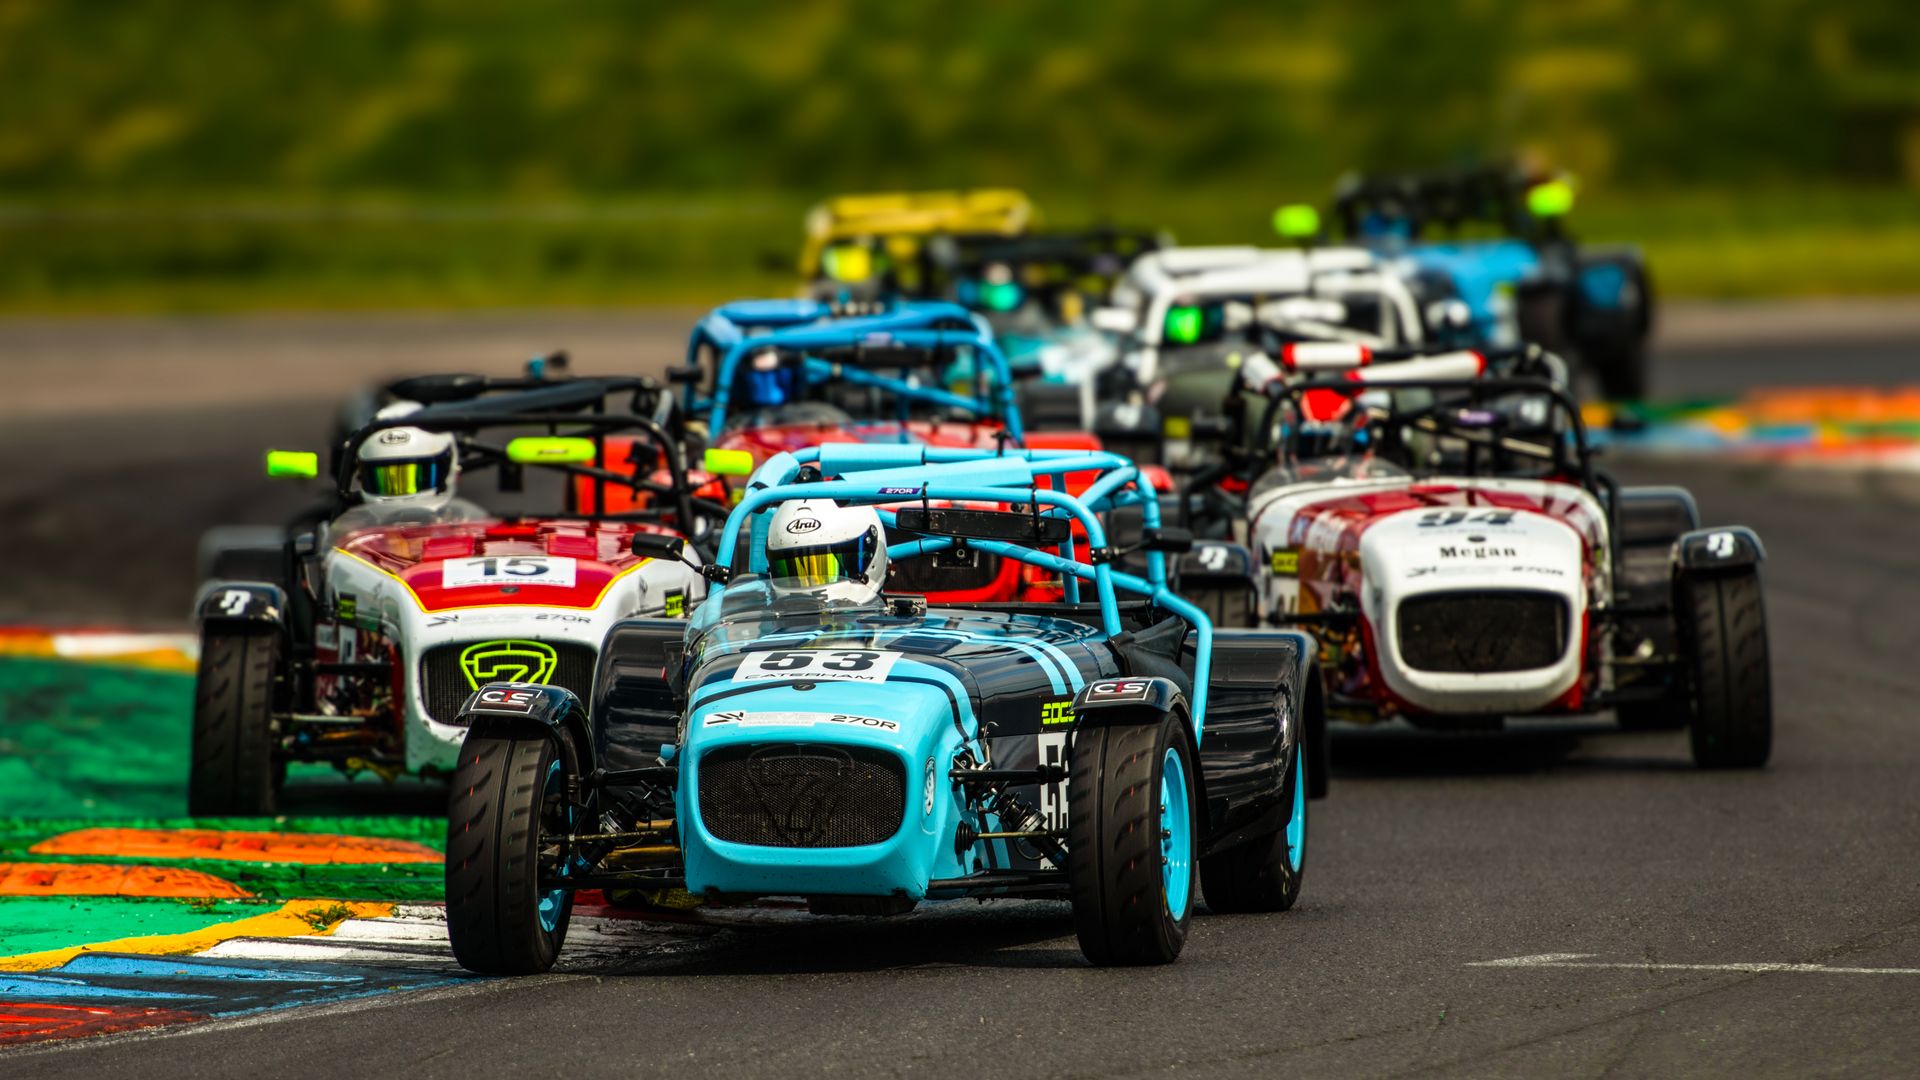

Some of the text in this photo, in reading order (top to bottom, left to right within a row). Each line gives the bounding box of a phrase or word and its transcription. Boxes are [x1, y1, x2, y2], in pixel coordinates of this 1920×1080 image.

[792, 519, 817, 530] Arai
[1439, 545, 1517, 559] Megan
[467, 557, 550, 577] 15
[535, 612, 592, 624] 270R
[759, 650, 881, 671] 53
[744, 671, 876, 681] CATERHAM
[830, 713, 898, 730] 270R
